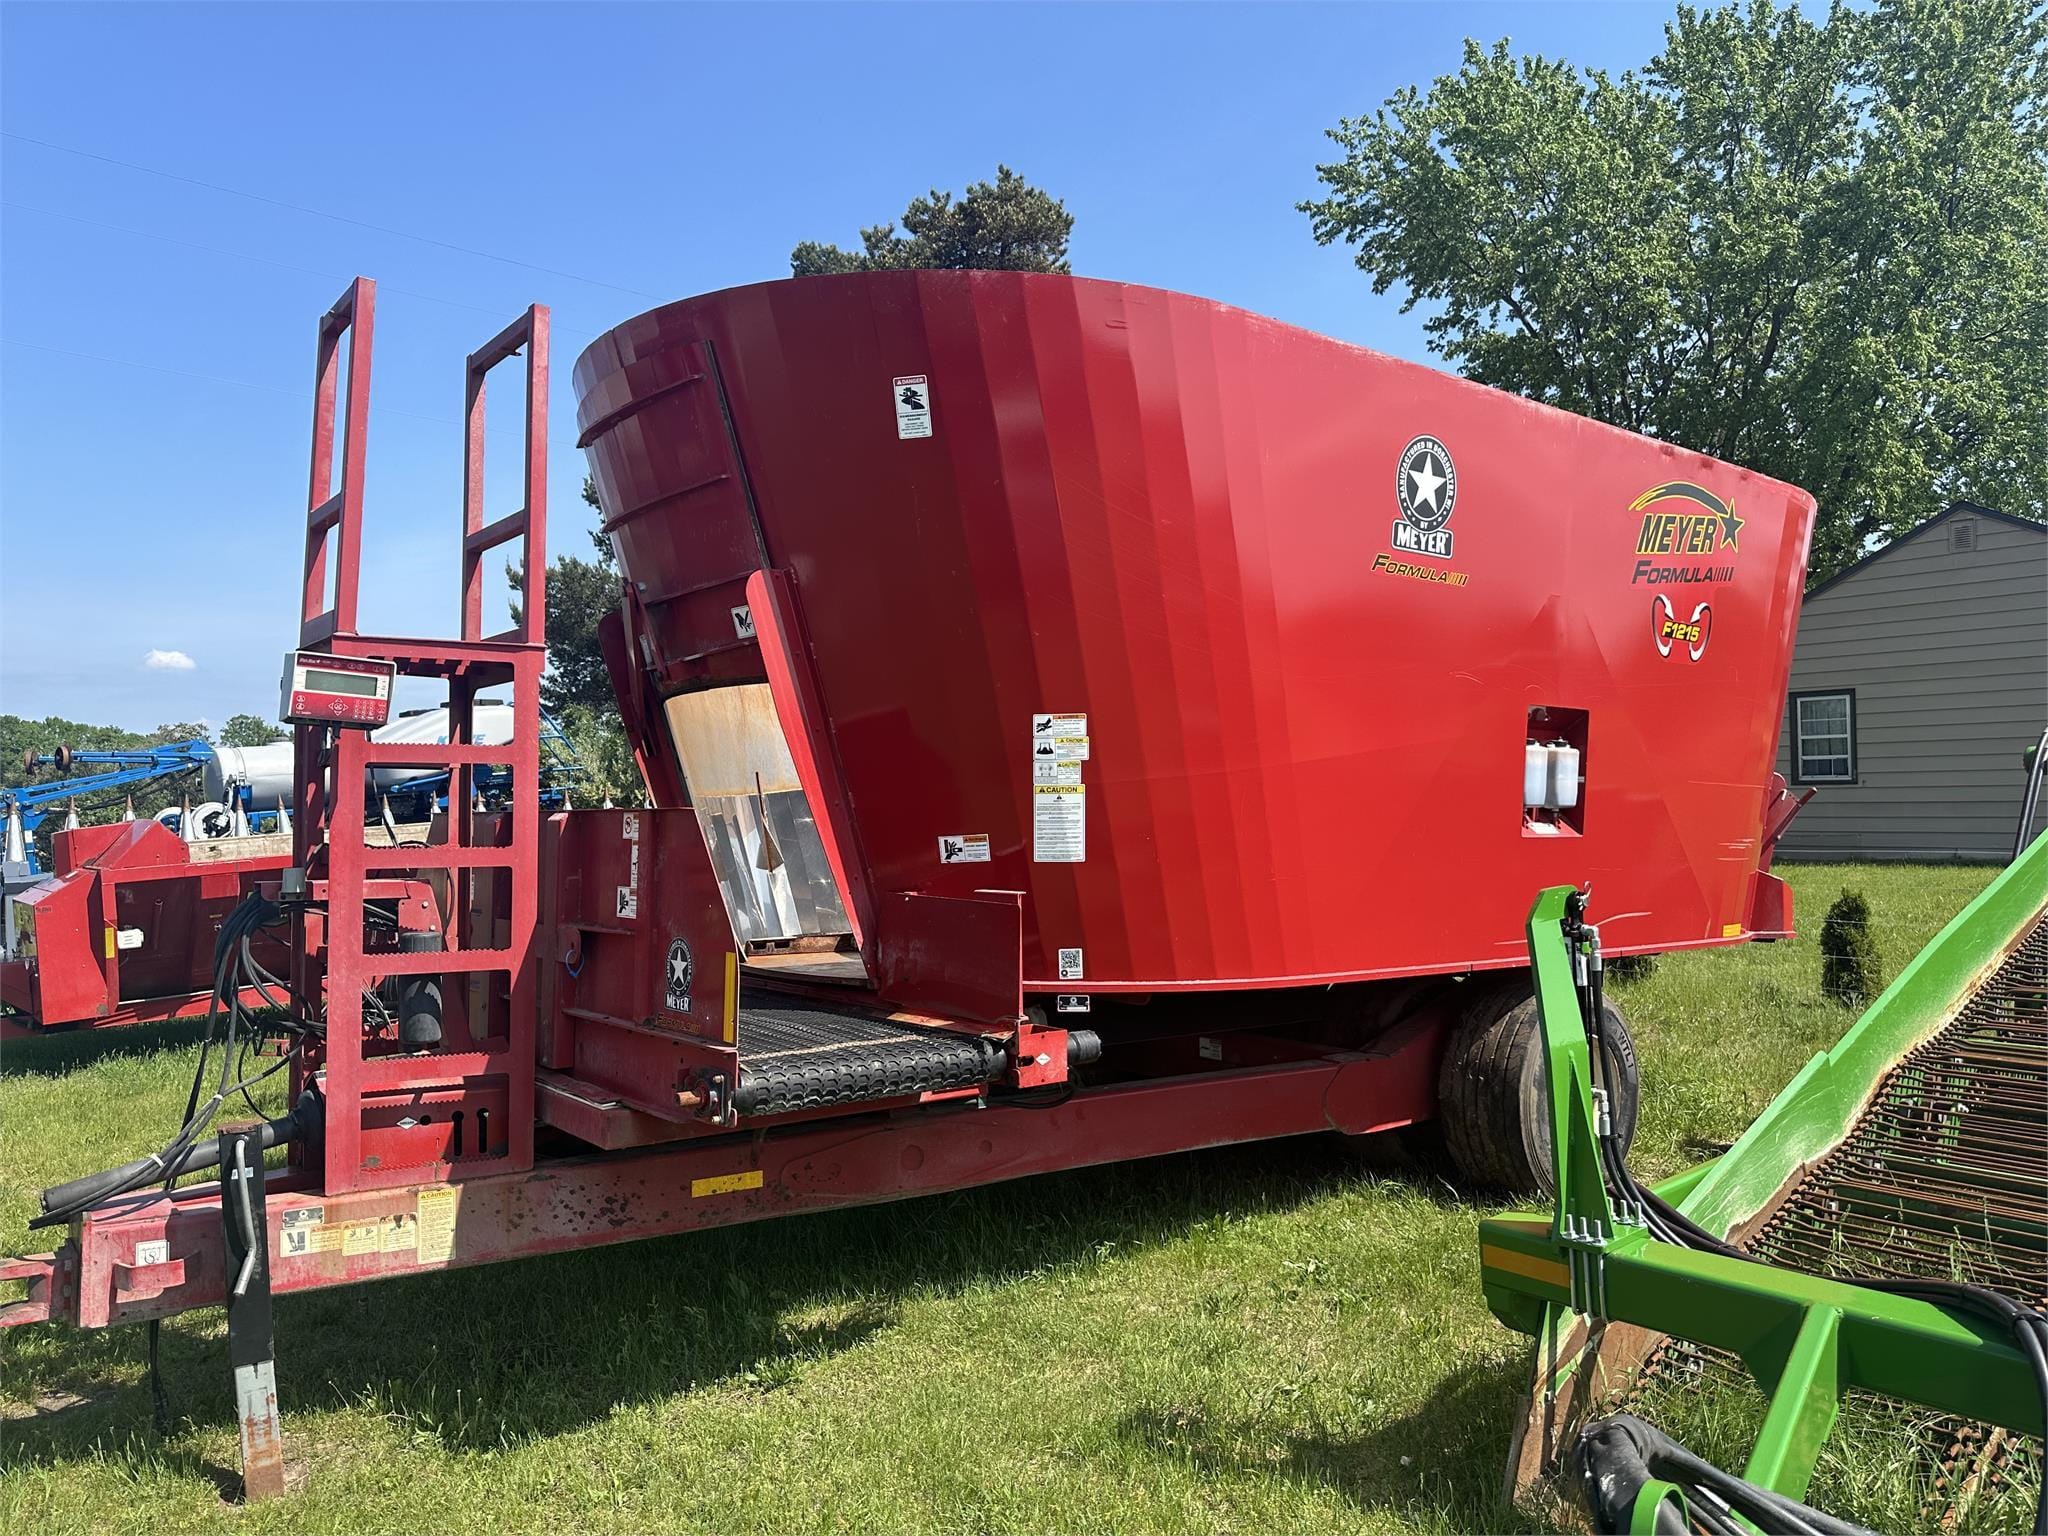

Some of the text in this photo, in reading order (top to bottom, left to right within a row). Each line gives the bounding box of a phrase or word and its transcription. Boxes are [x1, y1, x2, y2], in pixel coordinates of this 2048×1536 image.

[1396, 524, 1447, 555] MEYER
[1636, 513, 1719, 554] MEYER
[1661, 621, 1700, 642] F1215
[666, 993, 689, 1012] MEYER
[426, 1191, 452, 1199] CAUTION
